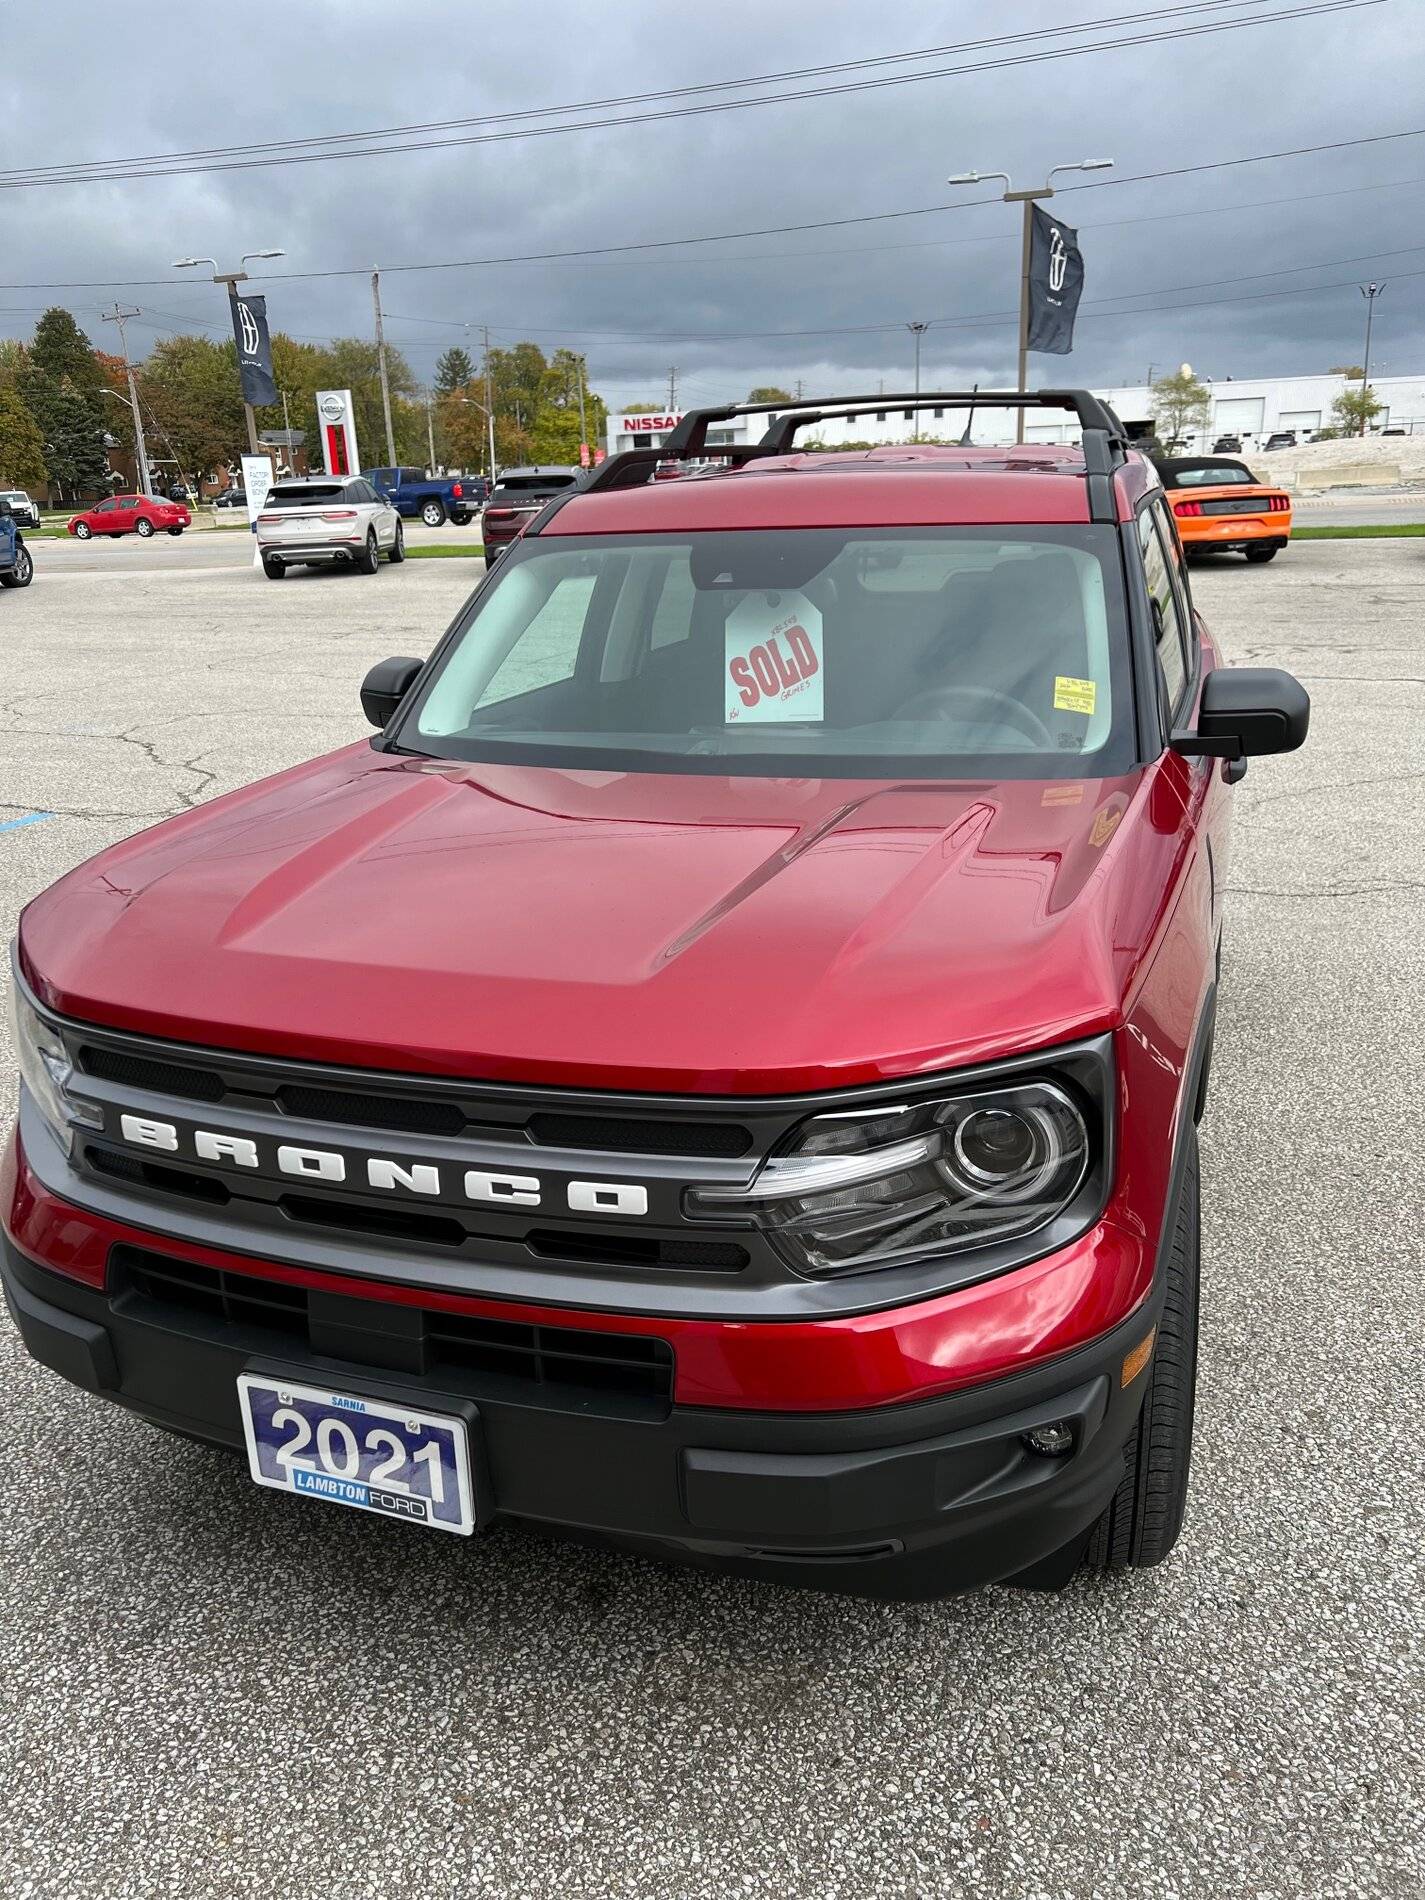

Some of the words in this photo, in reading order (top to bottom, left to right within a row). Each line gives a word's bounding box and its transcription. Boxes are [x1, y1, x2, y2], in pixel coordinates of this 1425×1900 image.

[729, 625, 819, 708] SOLD
[120, 1113, 648, 1216] BRONCO
[331, 1396, 366, 1412] SARNIA
[271, 1408, 445, 1503] 2021
[297, 1473, 366, 1502] LAMBTON
[369, 1491, 426, 1516] FORD
